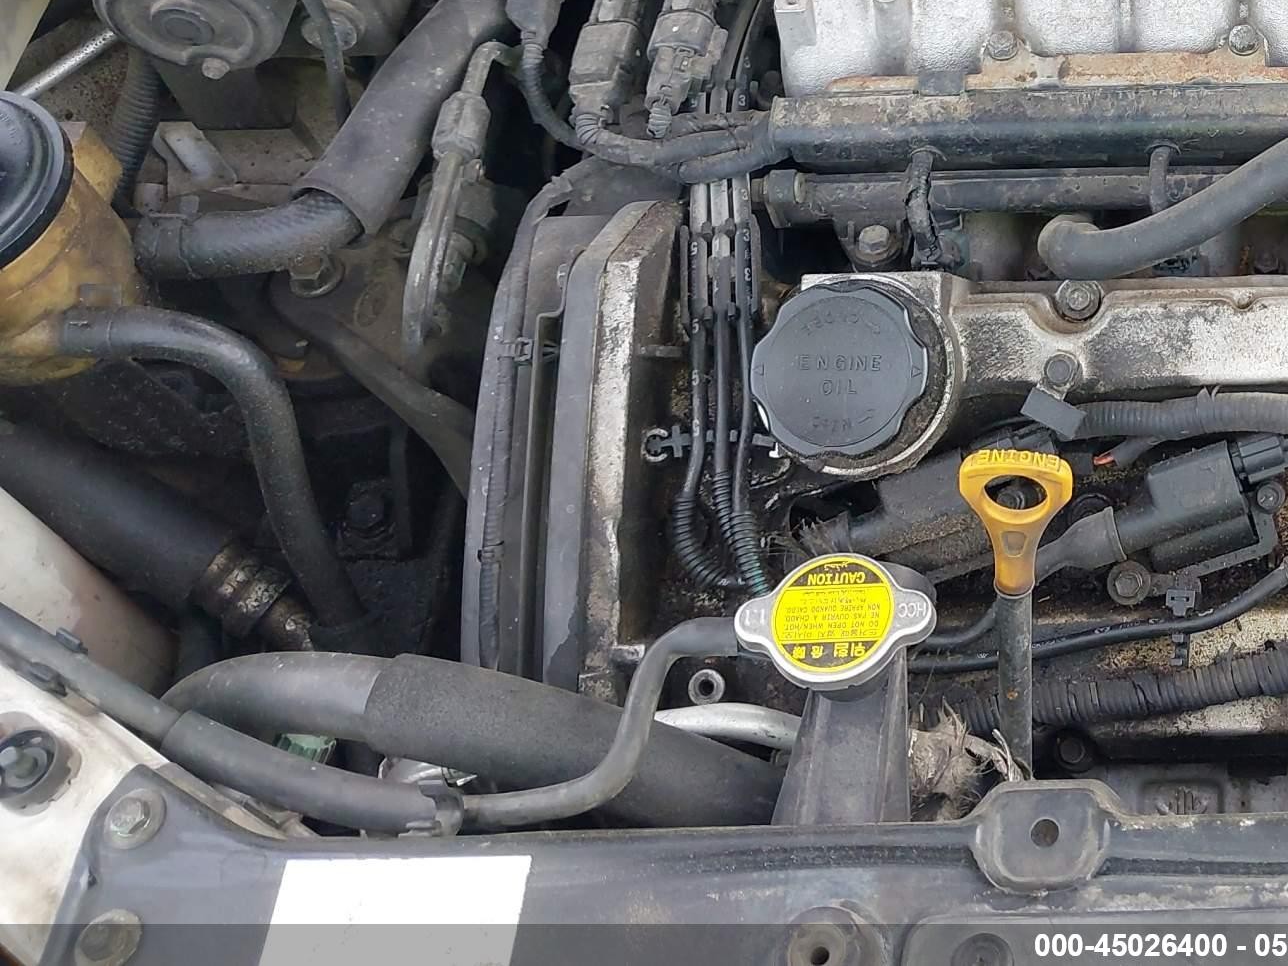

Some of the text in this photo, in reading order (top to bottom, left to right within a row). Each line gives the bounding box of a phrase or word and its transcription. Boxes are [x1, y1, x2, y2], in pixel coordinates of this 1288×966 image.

[738, 94, 747, 107] 3
[741, 188, 749, 201] 3
[743, 227, 751, 242] 3
[690, 241, 698, 256] 5
[692, 318, 700, 334] 5
[799, 354, 882, 372] ENGINE
[692, 369, 700, 385] 5
[823, 379, 857, 395] OIL
[978, 449, 1060, 472] ENGINE
[807, 571, 866, 586] CAUTION
[897, 600, 927, 618] HCC
[827, 621, 847, 629] OPEN
[850, 620, 865, 628] NOT
[868, 620, 879, 628] DO
[832, 642, 866, 659] 위험
